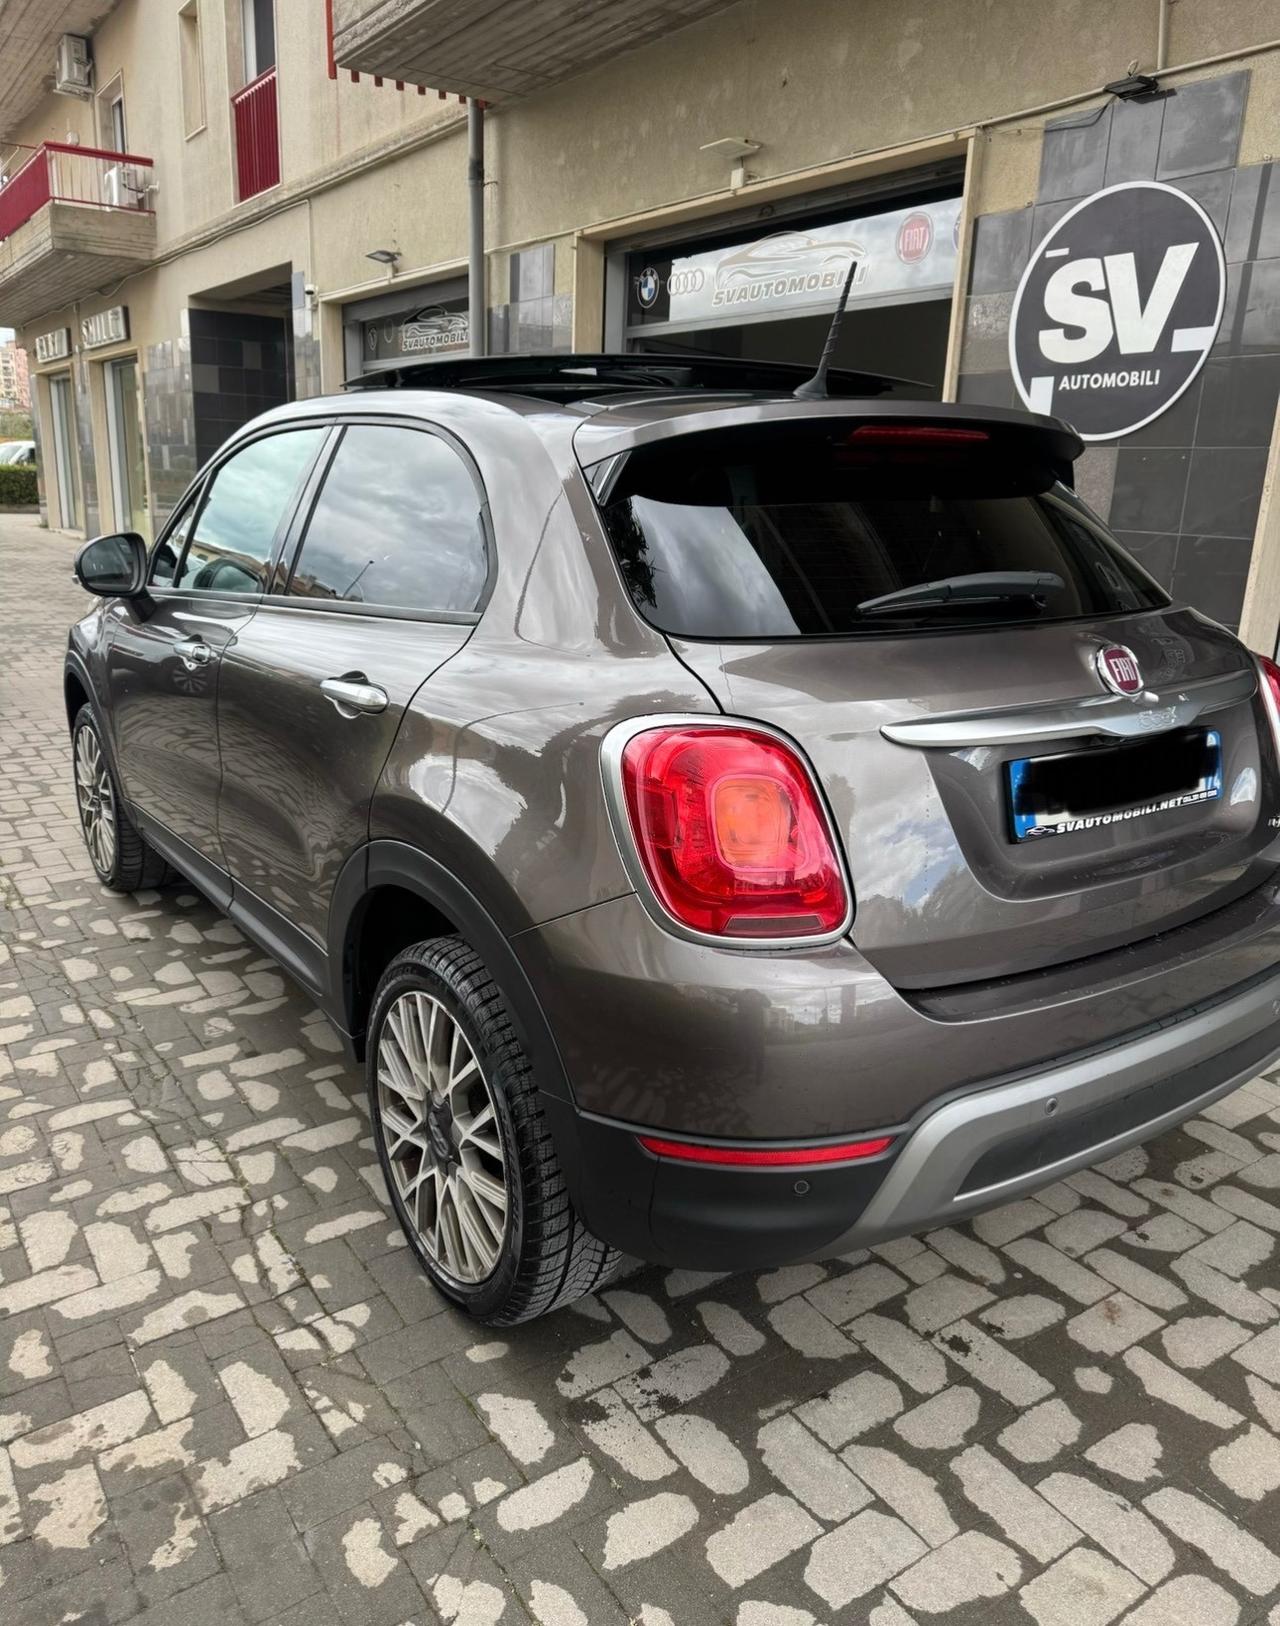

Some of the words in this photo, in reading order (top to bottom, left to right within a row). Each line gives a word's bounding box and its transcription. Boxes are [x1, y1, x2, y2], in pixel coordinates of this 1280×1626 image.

[712, 264, 869, 307] SVAUTOMOBII
[1038, 242, 1200, 364] SV
[1058, 369, 1161, 391] AUTOMOBILI
[1108, 657, 1137, 683] FIAT
[1056, 796, 1183, 834] SVAUTOMOBILI.NET
